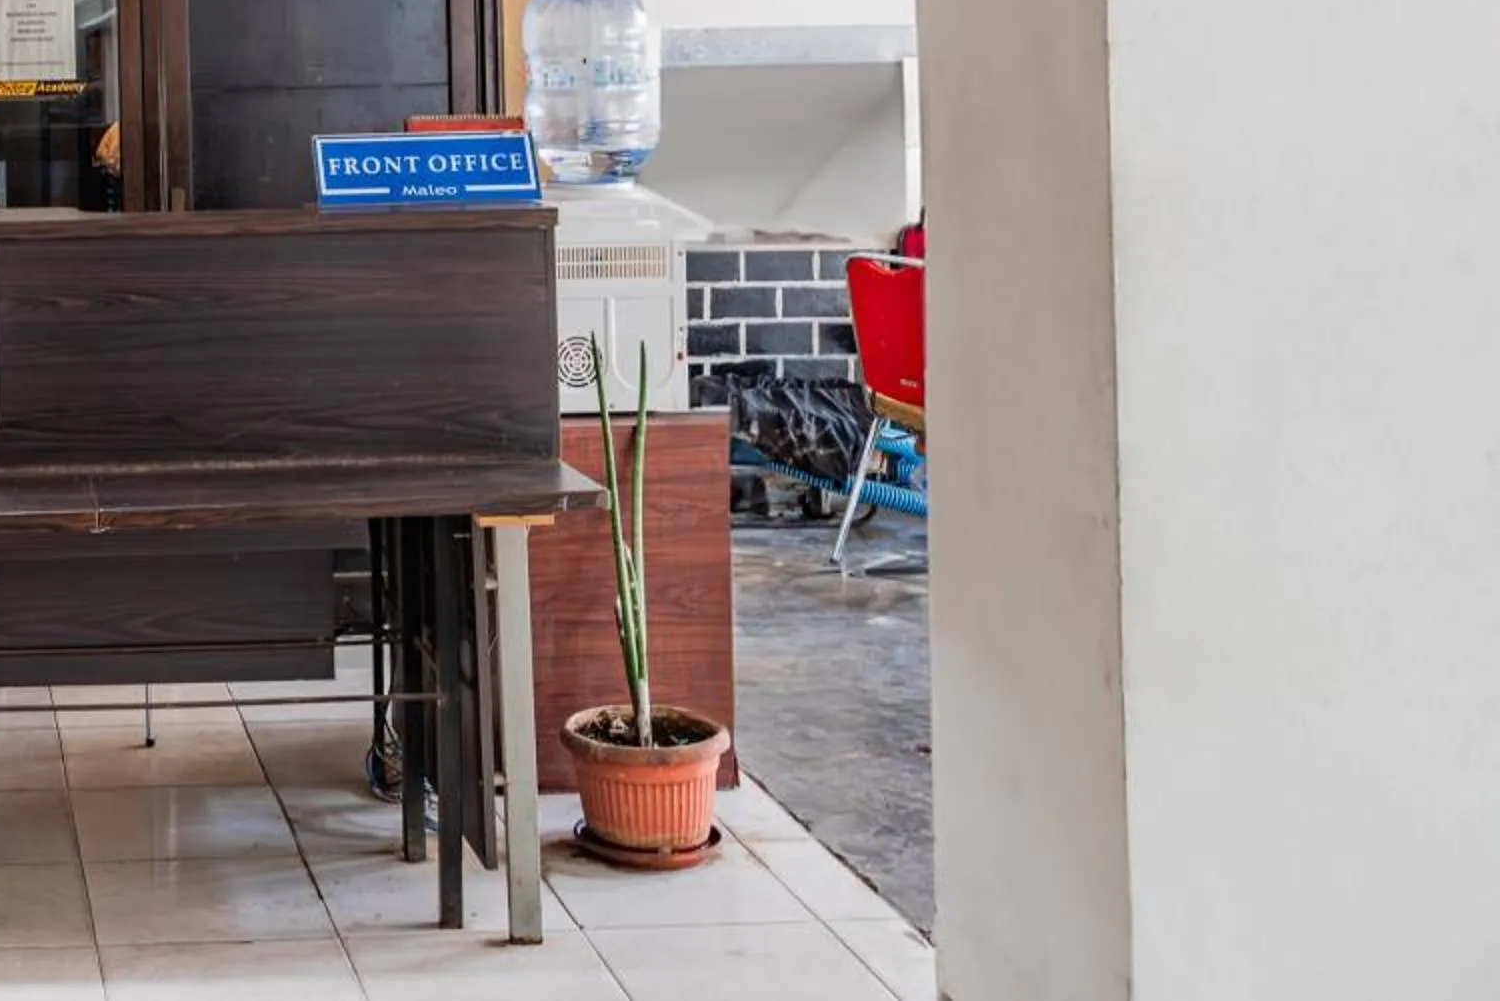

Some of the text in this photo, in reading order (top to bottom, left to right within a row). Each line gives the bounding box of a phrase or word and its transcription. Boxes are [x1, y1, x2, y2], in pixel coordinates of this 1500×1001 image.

[328, 152, 525, 176] FRONT OFFICE
[402, 184, 458, 197] Maleo
